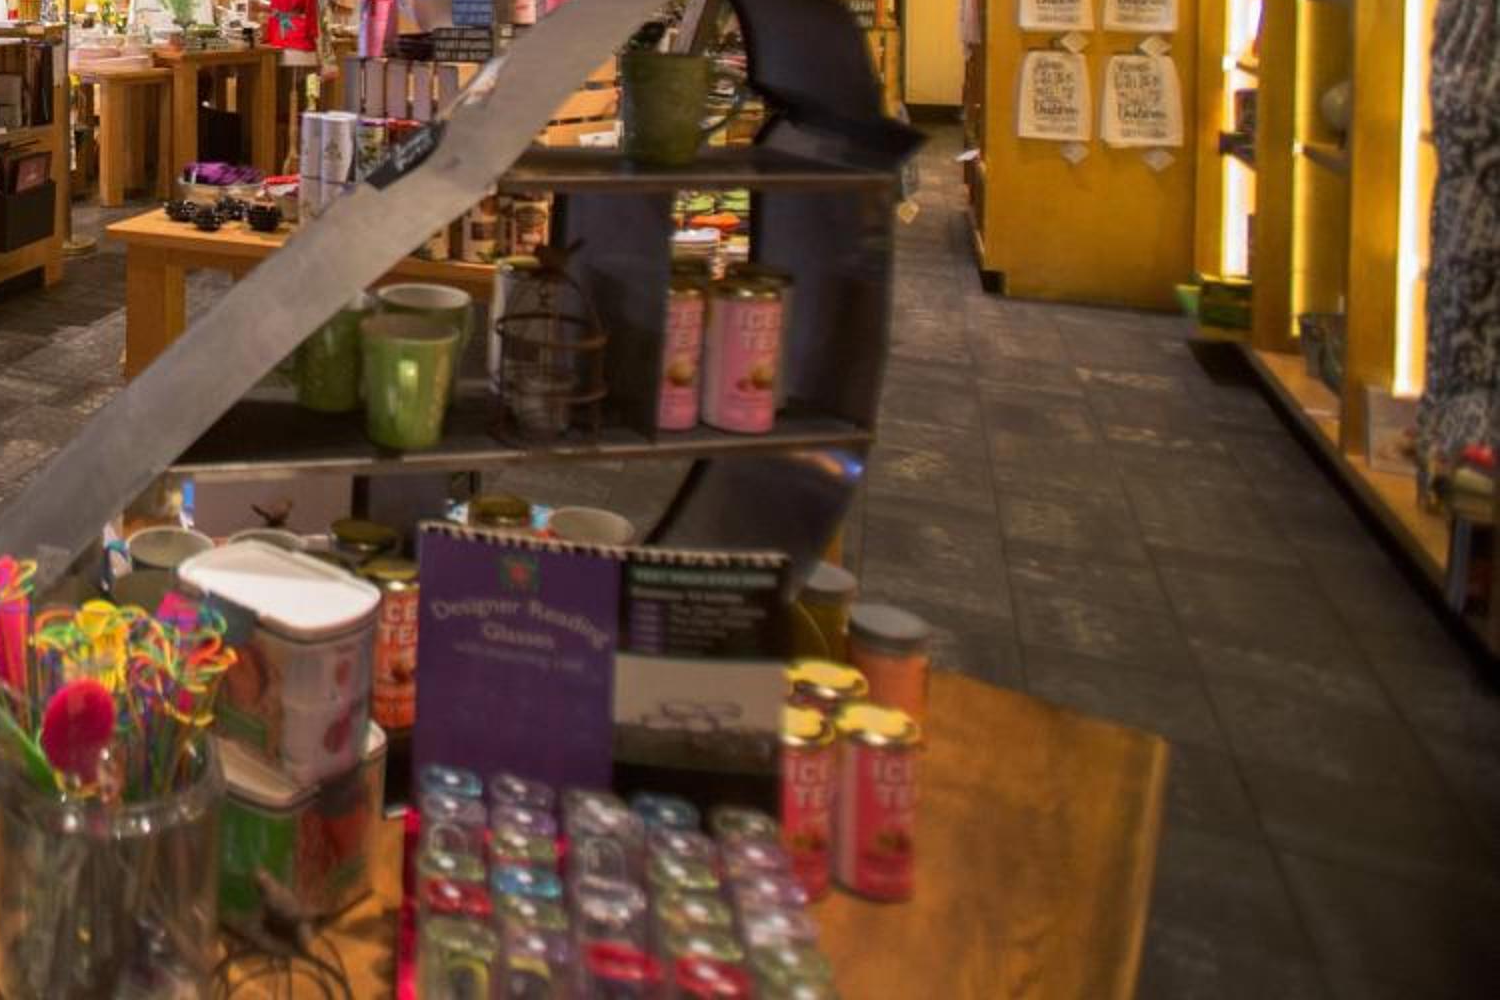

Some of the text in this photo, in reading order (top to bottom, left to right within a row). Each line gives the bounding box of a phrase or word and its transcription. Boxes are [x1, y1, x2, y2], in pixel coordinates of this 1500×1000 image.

[430, 600, 521, 622] Designer
[529, 599, 610, 649] Reading
[482, 621, 556, 649] Glasses
